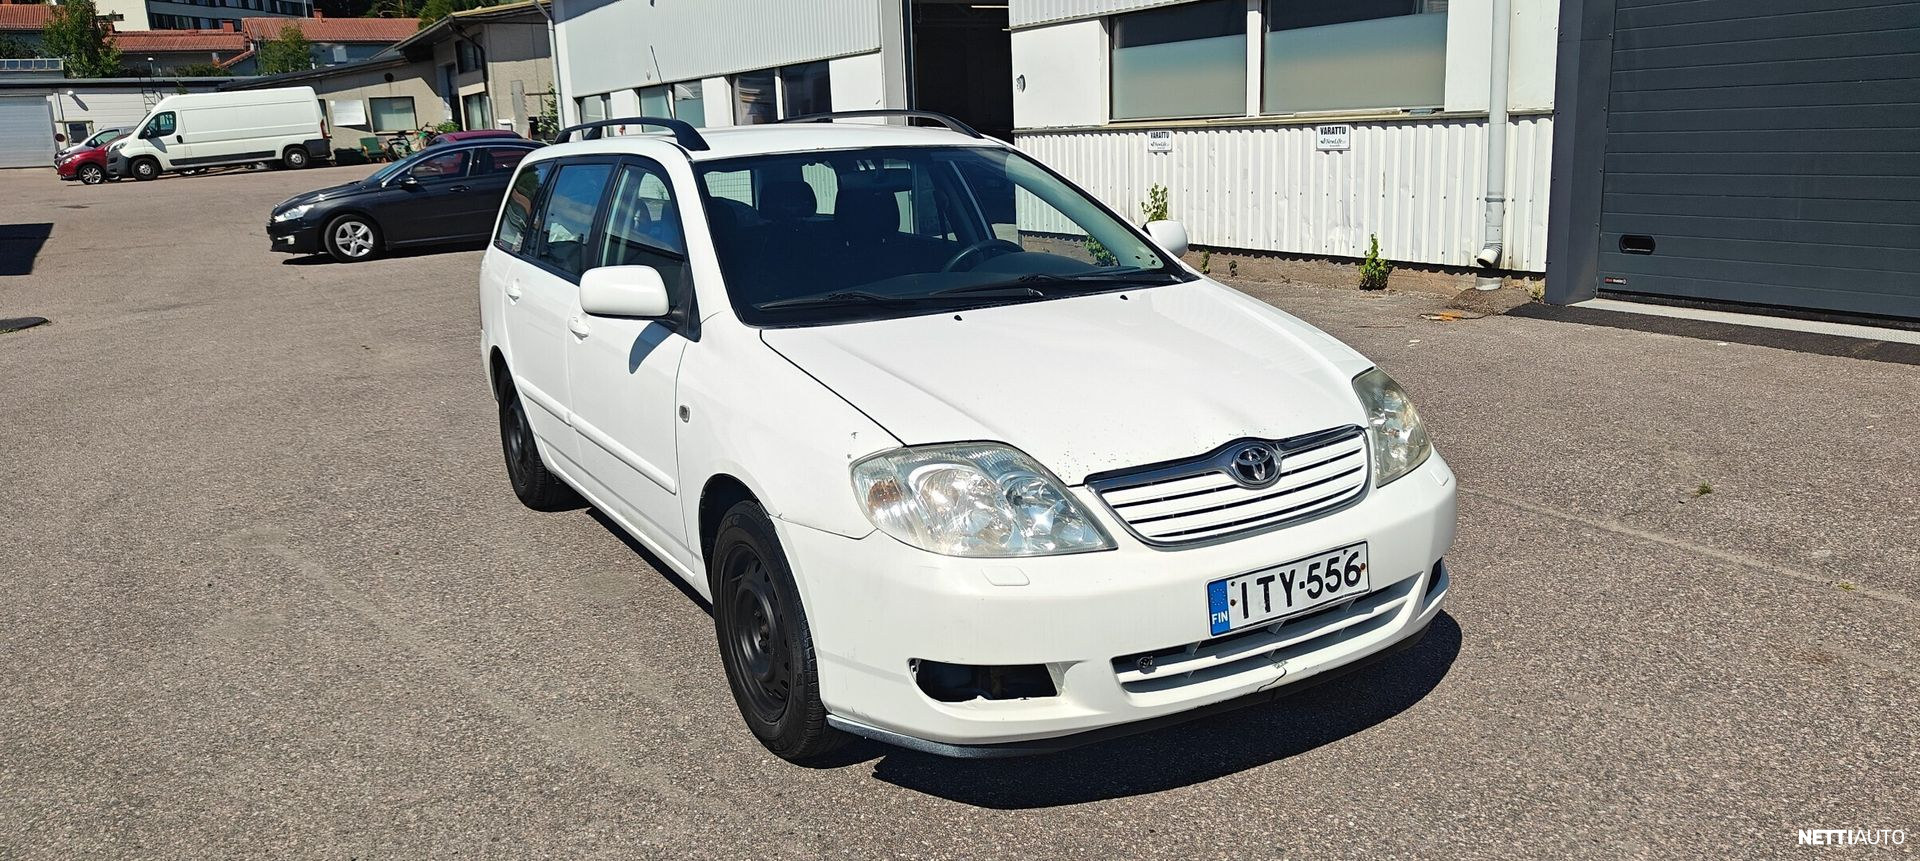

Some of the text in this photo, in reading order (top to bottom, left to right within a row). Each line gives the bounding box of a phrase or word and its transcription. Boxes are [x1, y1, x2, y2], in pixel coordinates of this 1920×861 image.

[1320, 126, 1346, 135] VARATTU
[1241, 551, 1361, 619] ITY-556
[1212, 611, 1229, 625] FIN
